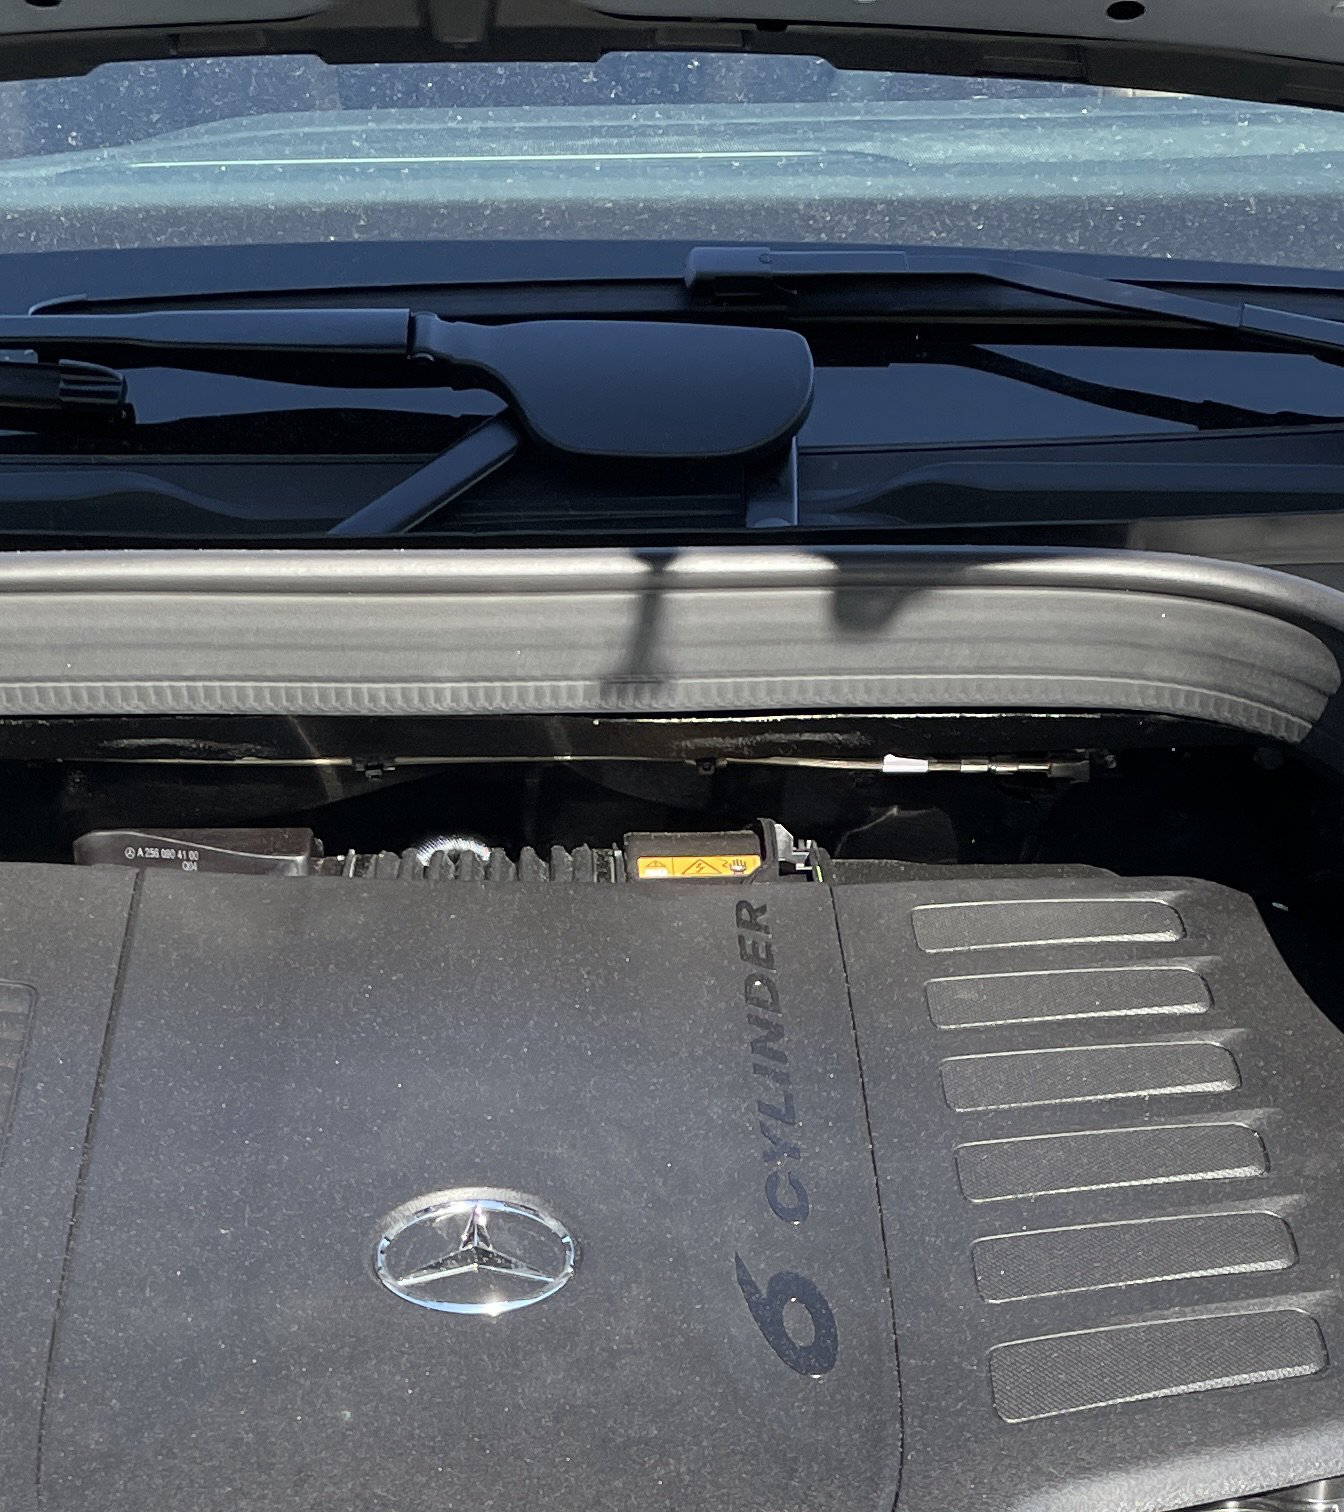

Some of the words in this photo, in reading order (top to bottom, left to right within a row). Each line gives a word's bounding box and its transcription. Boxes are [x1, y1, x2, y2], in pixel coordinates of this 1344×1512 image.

[136, 847, 144, 857] A
[144, 847, 160, 858] 256
[177, 850, 187, 860] 41
[188, 850, 199, 861] 00
[735, 899, 811, 1225] CYLINDER
[734, 1250, 839, 1377] 6
